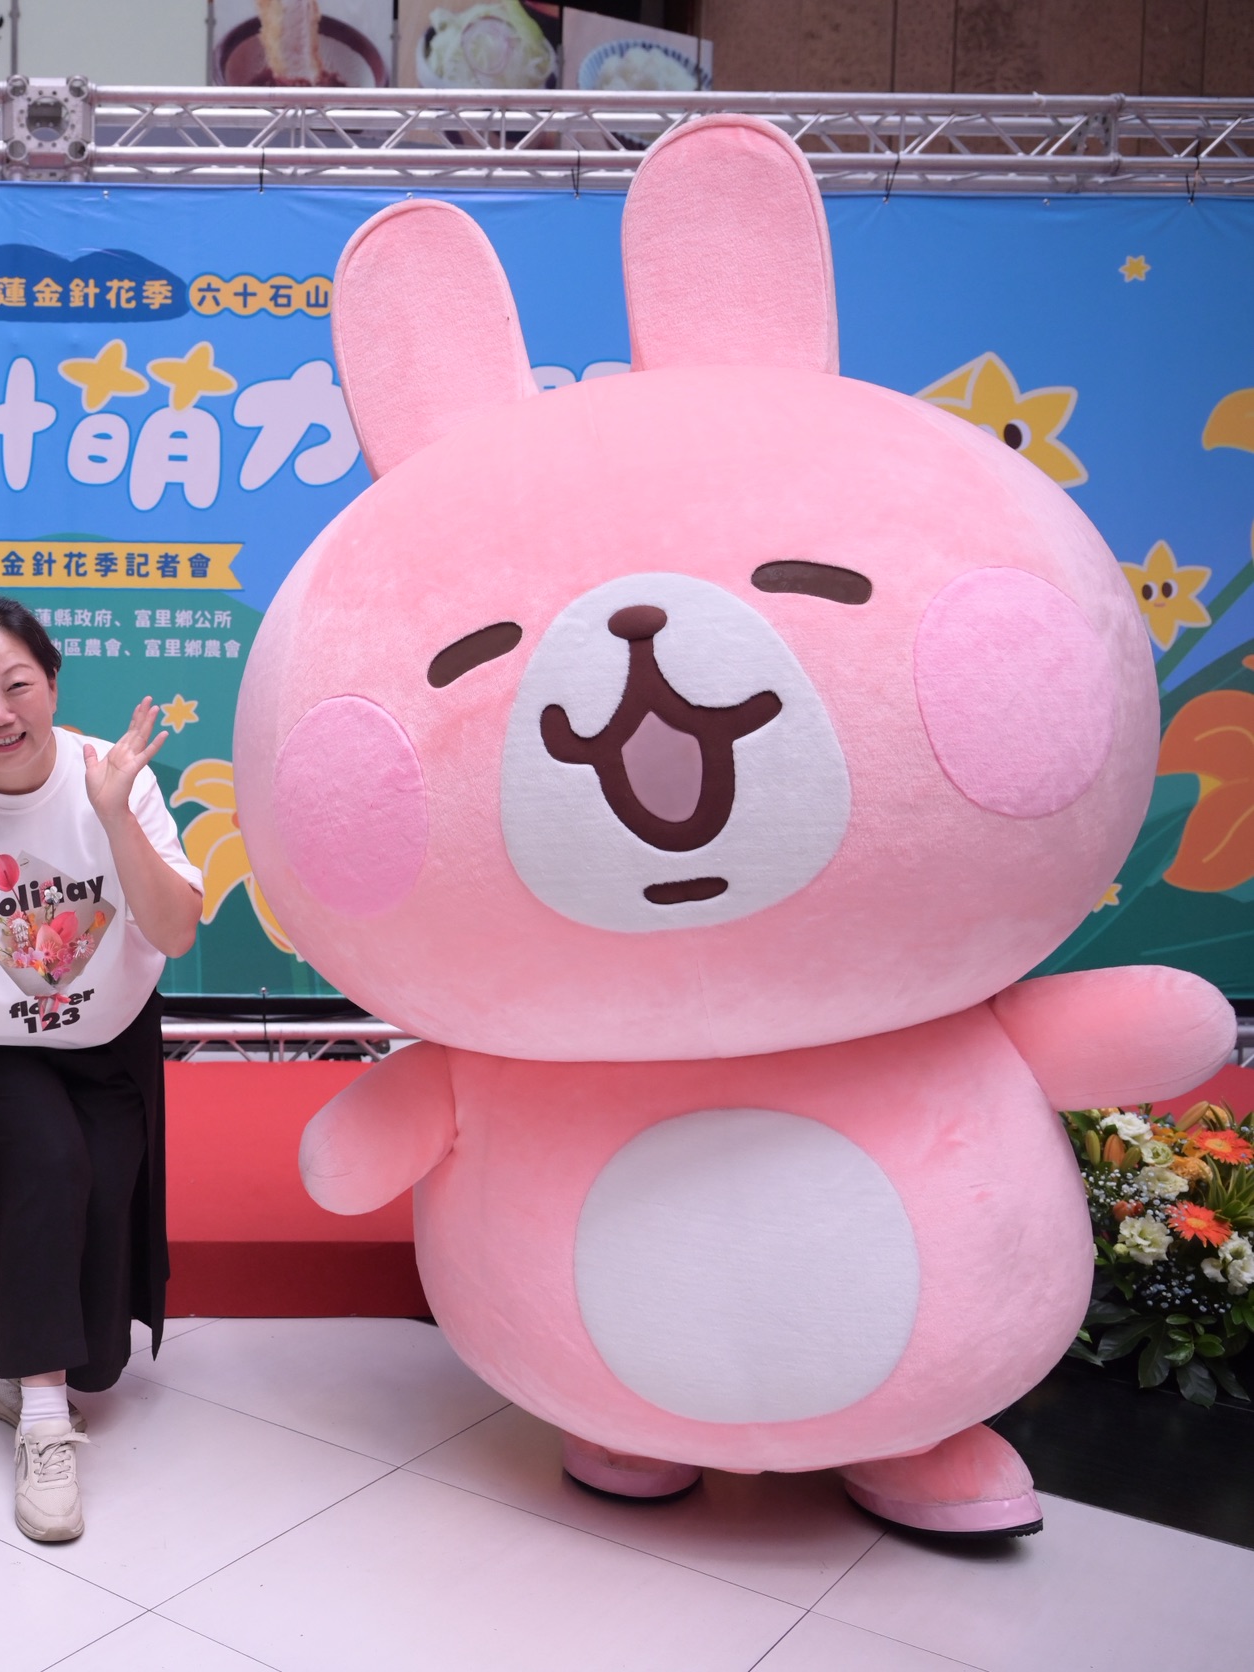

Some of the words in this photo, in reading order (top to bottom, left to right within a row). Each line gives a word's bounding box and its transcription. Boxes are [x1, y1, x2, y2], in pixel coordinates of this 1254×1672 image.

[197, 282, 329, 309] 六十石山
[9, 988, 95, 1018] floer
[24, 1007, 81, 1034] 123
